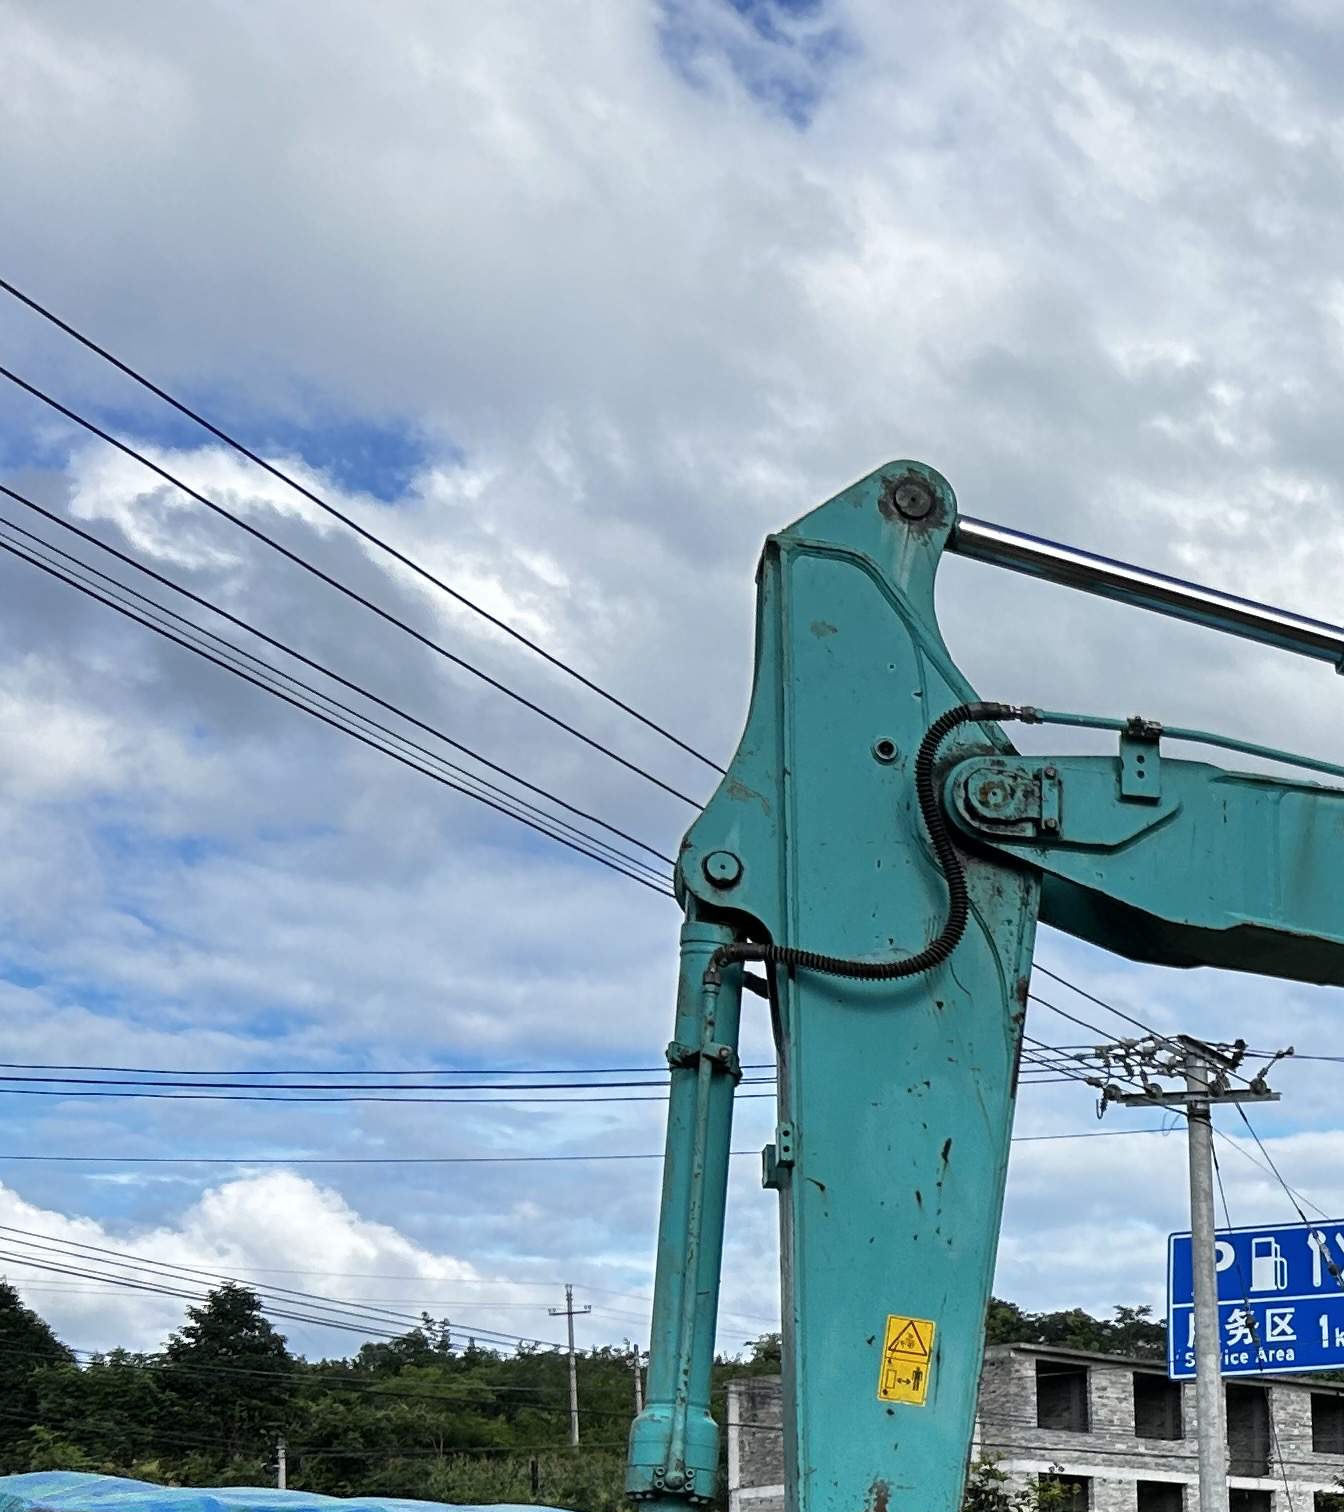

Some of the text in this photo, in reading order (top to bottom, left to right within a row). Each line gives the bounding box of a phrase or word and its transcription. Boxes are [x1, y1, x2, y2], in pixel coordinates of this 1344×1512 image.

[1187, 1307, 1297, 1348] 务区
[1185, 1346, 1295, 1368] Sice Area
